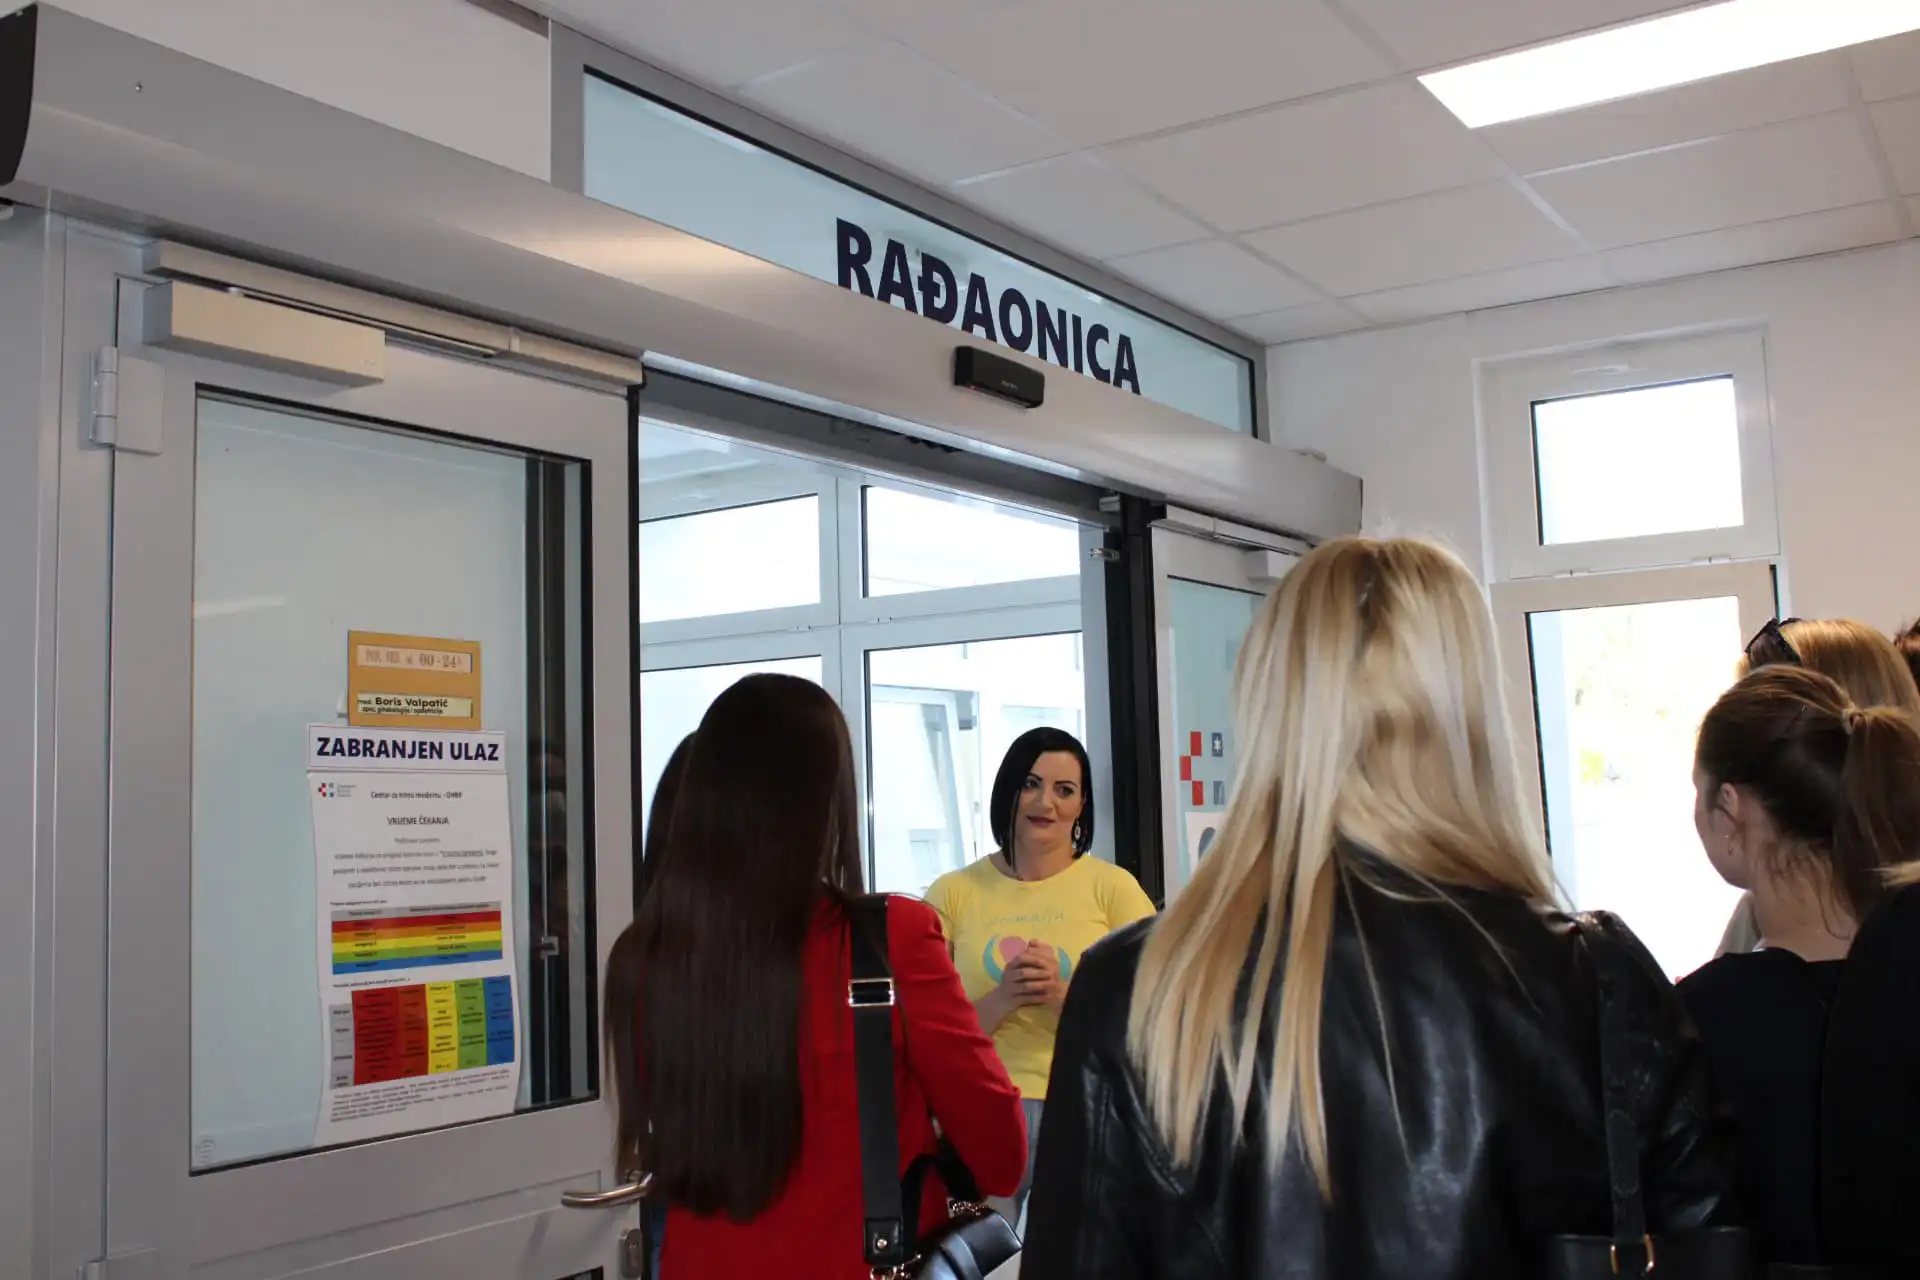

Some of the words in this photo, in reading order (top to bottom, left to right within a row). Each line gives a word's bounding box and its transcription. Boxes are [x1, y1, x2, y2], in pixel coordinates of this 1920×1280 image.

[836, 217, 1141, 395] RAĐAONICA
[375, 696, 402, 706] Boris
[404, 697, 449, 710] Valpatić
[316, 736, 443, 760] ZABRANJEN
[450, 742, 500, 761] ULAZ
[386, 815, 417, 826] VRIJEME
[418, 813, 450, 826] ČEKANJA
